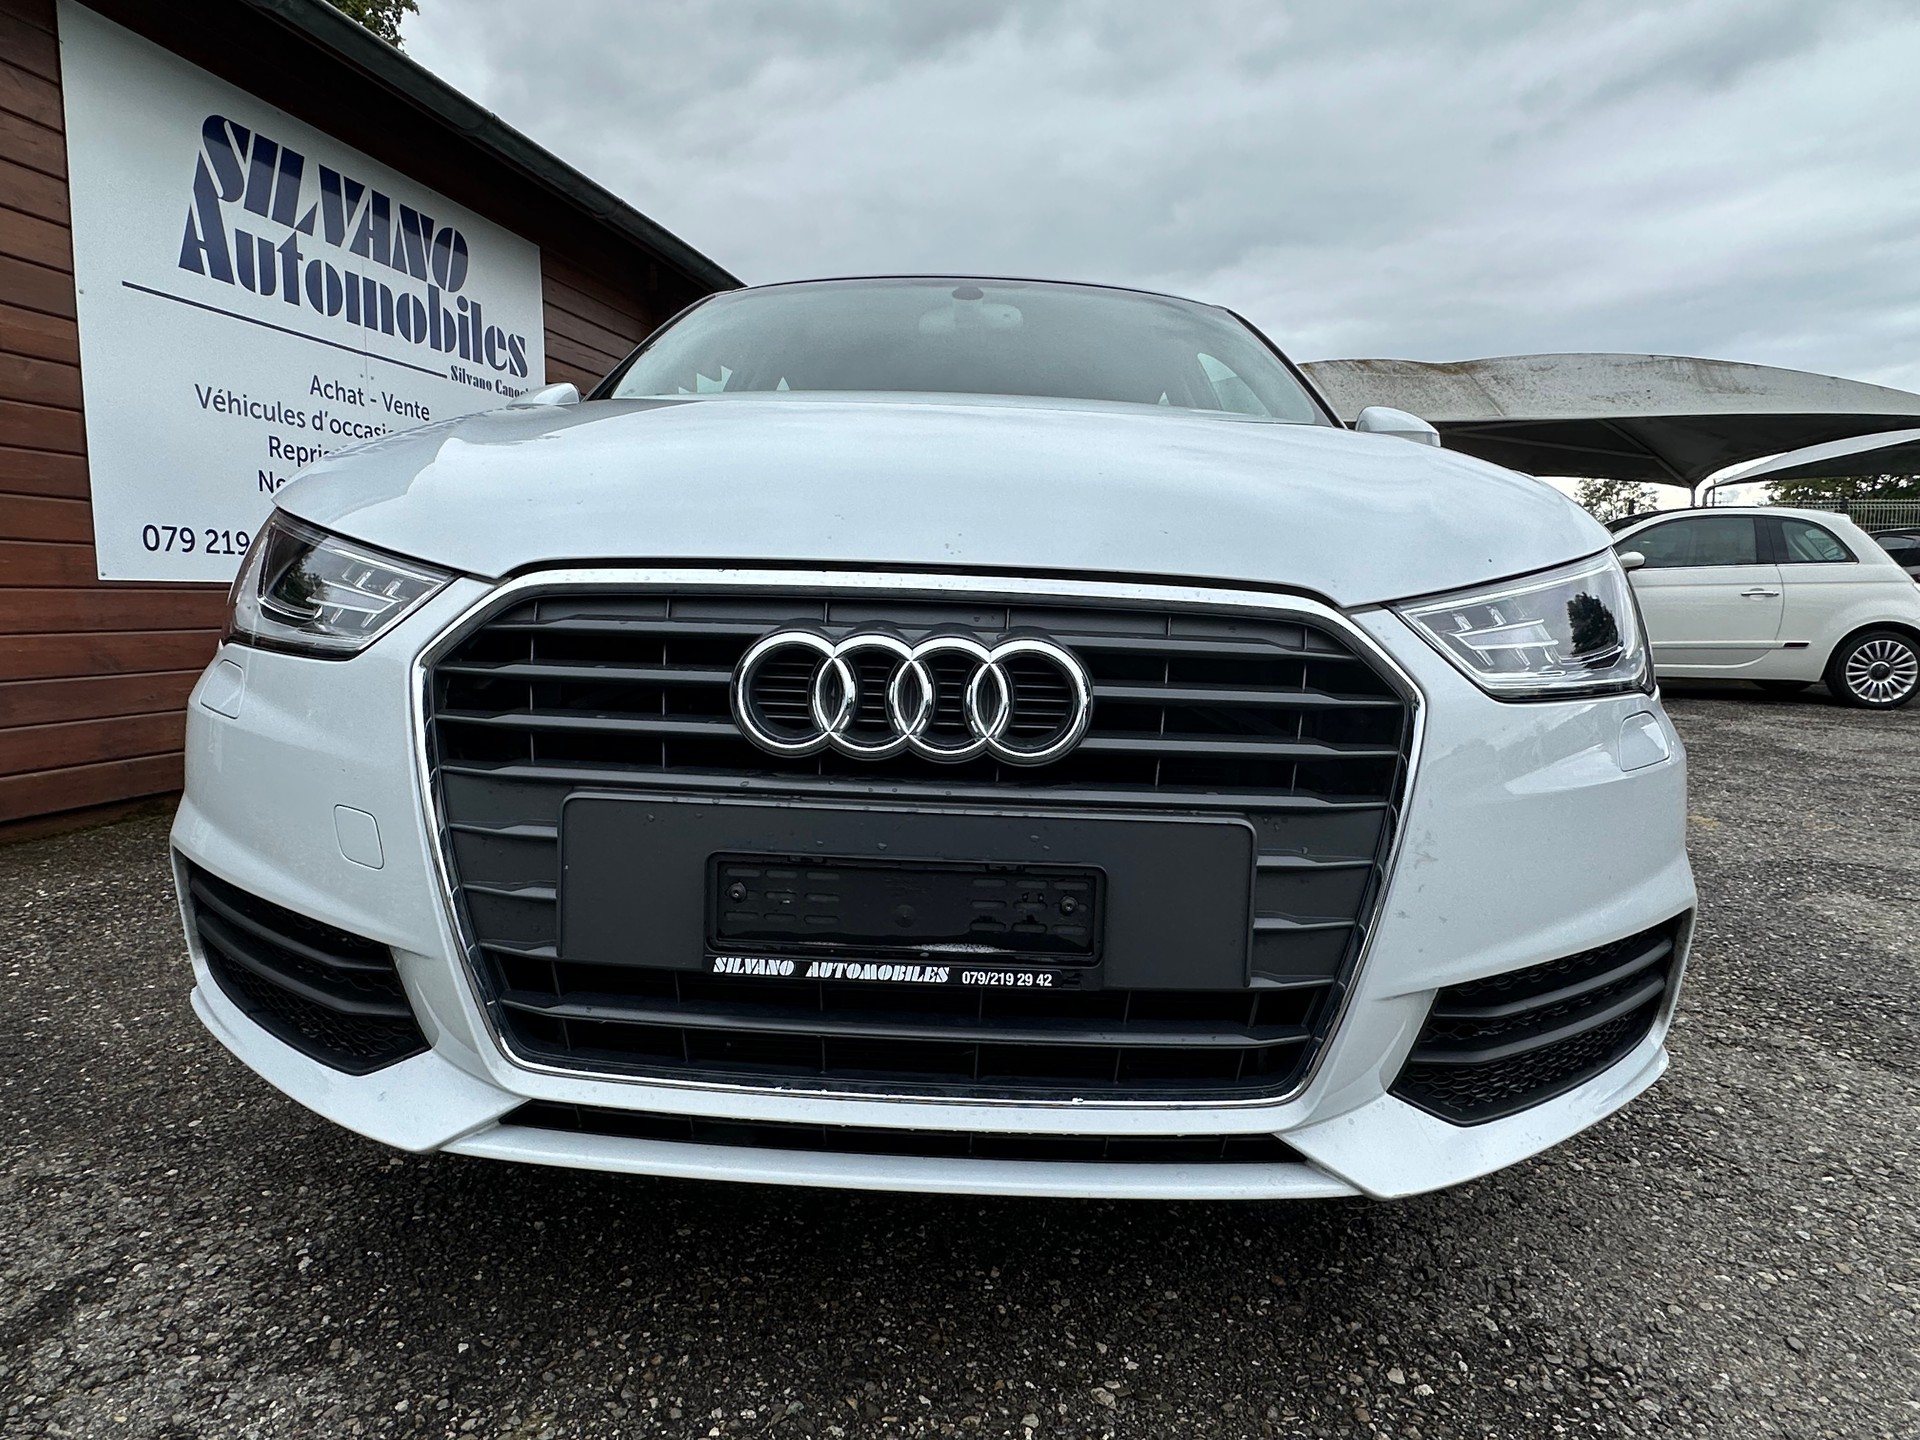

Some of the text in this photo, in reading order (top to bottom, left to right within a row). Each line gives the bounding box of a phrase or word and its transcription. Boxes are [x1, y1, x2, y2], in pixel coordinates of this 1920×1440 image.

[193, 114, 469, 293] SILVANO
[178, 197, 529, 378] Automobiles
[309, 374, 365, 407] Achat
[381, 391, 430, 421] Vente
[450, 365, 492, 392] Silvano
[194, 384, 394, 439] Véhicules d'occasi
[268, 435, 329, 467] Repri
[142, 524, 250, 556] 079 219
[713, 957, 1053, 987] SILVANO AUTOMOBILES 079/219 29 42
